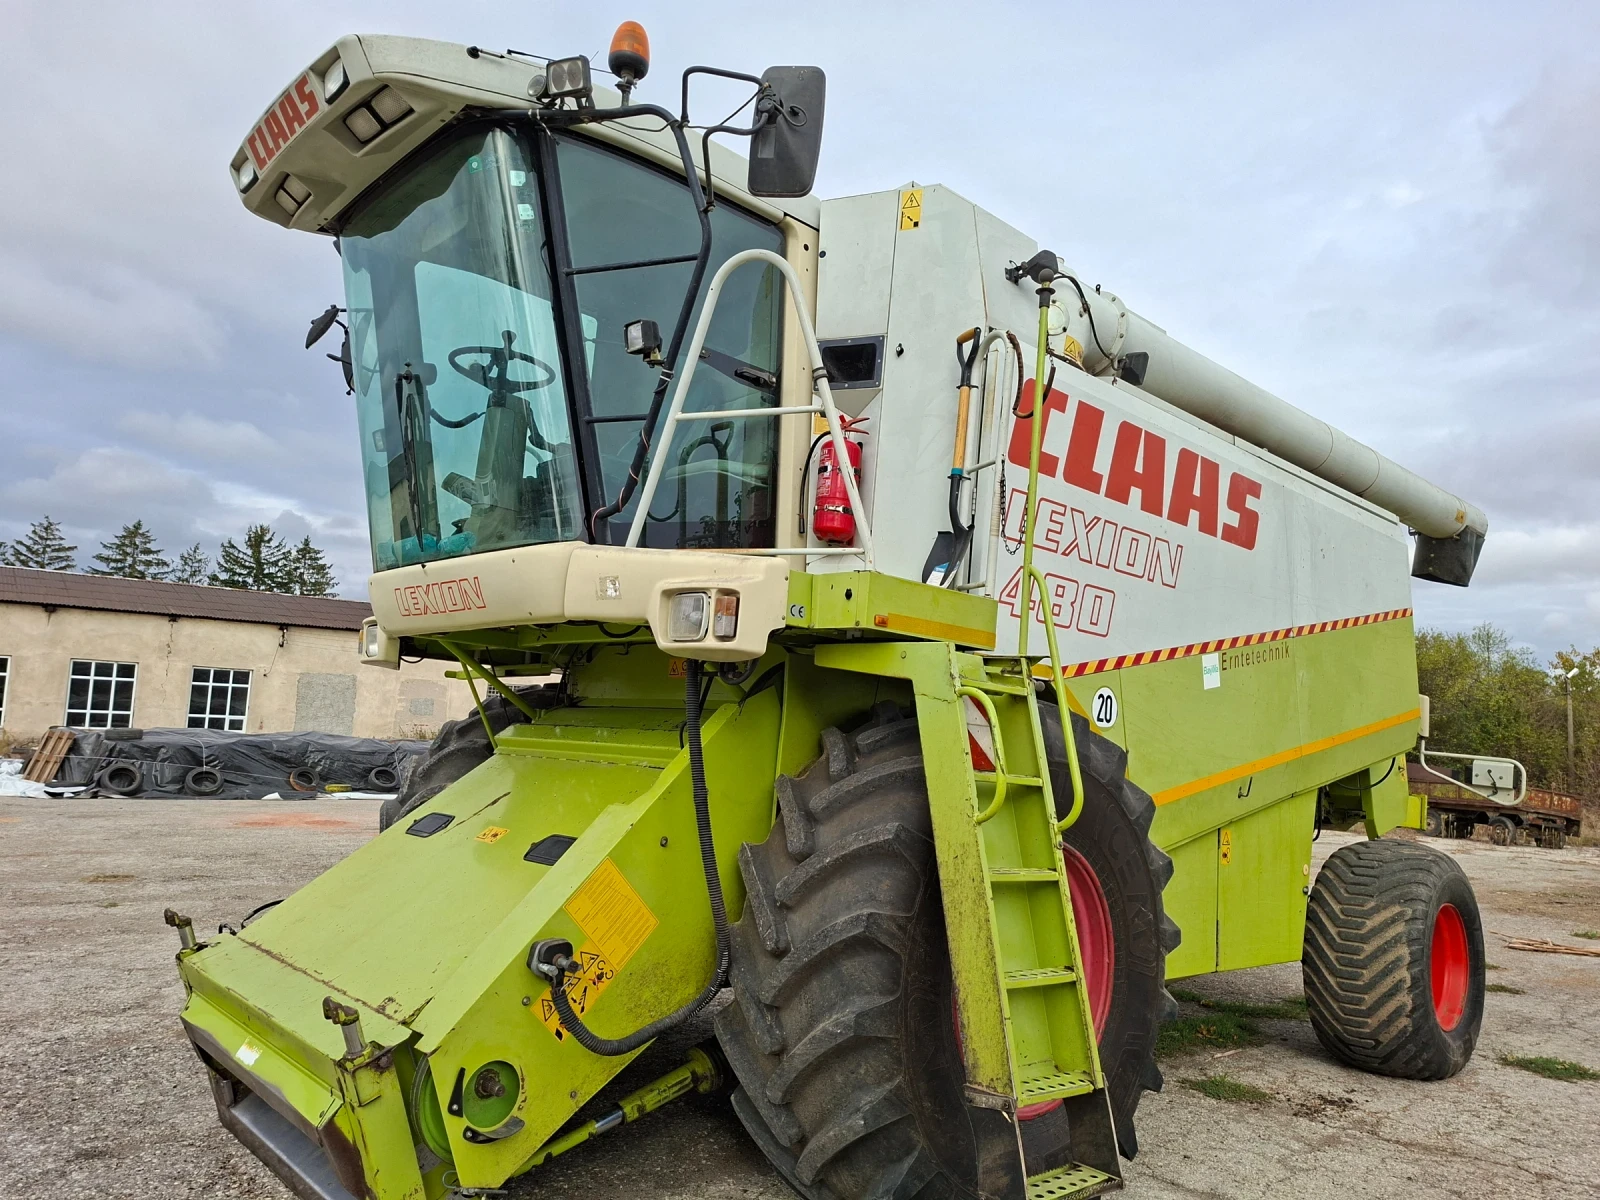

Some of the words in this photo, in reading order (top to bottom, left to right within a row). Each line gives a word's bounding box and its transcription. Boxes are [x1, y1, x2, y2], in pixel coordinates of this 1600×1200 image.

[247, 73, 319, 170] CLAAS
[1008, 377, 1262, 551] CLAAS
[1004, 488, 1184, 589] LEXION
[394, 576, 486, 617] LEXION
[999, 565, 1116, 638] 480
[1221, 643, 1290, 671] Erntetechnik
[1097, 694, 1113, 724] 20
